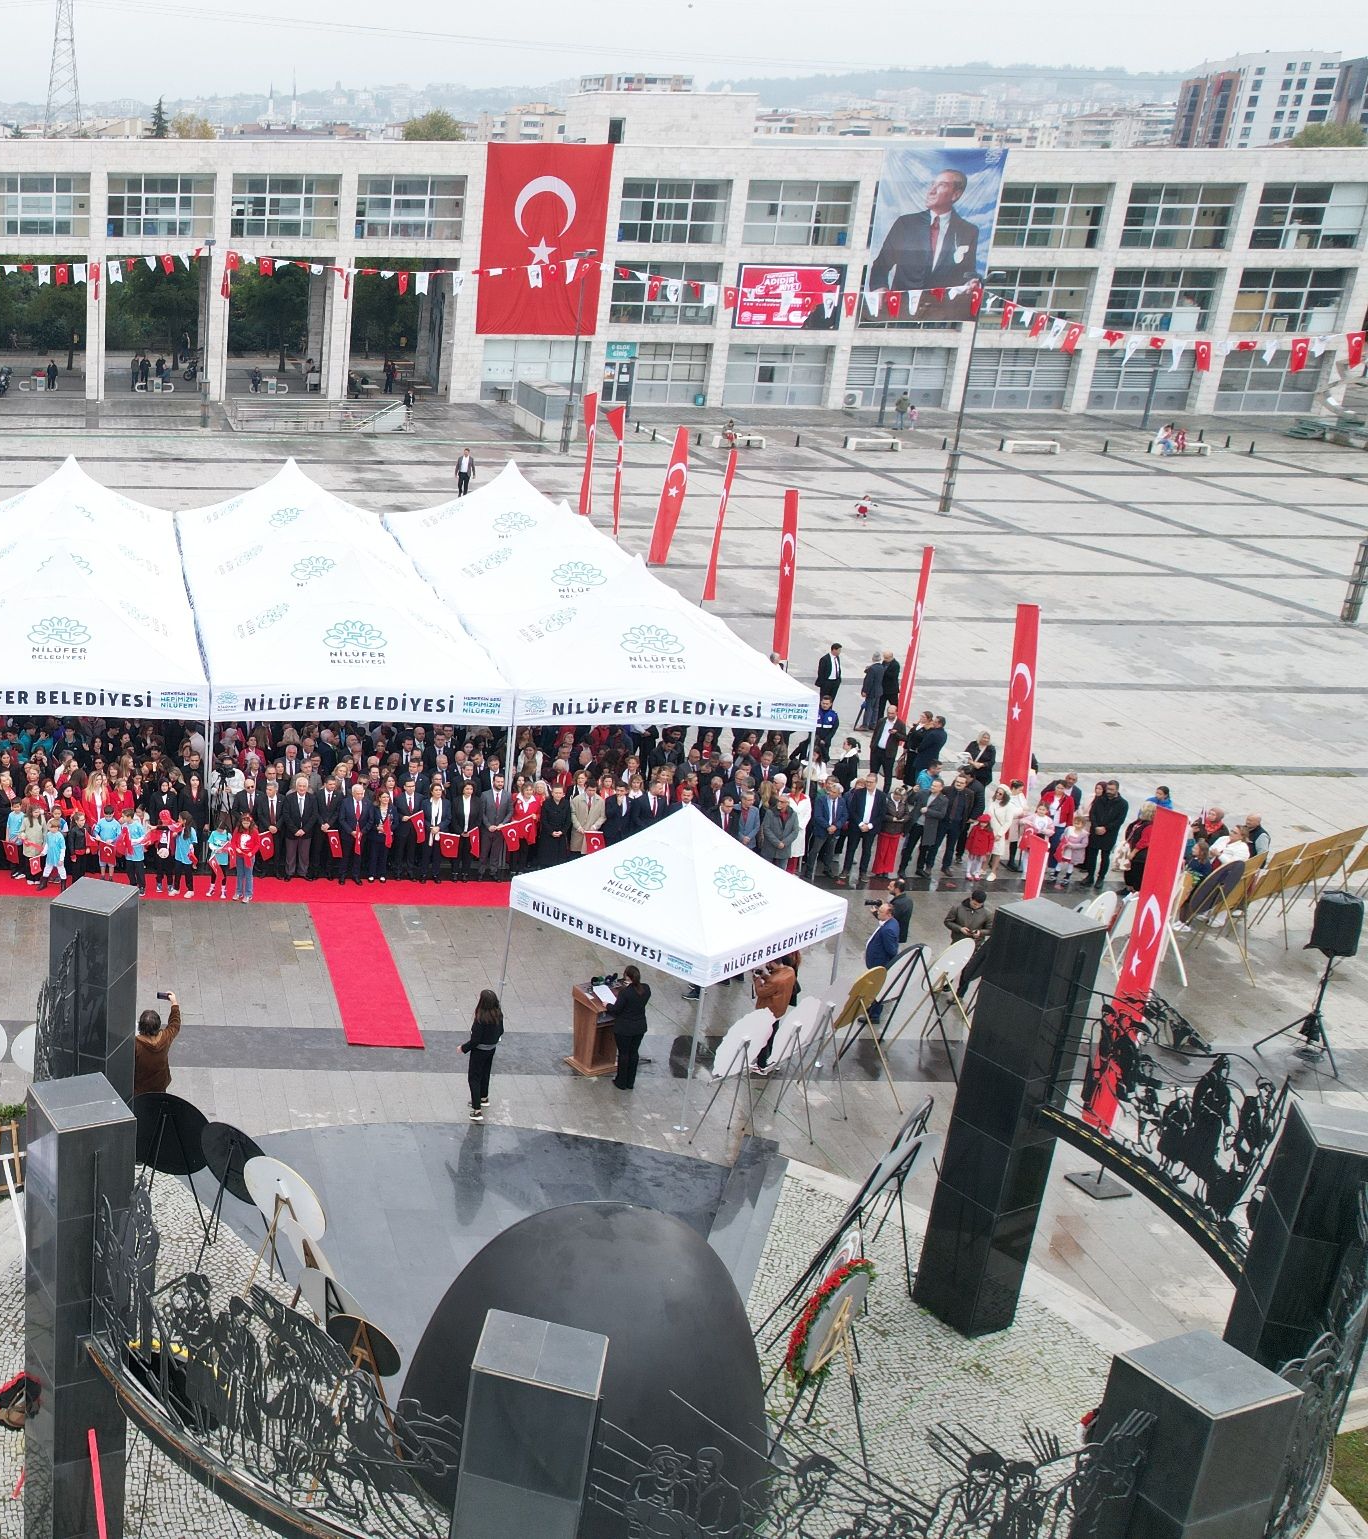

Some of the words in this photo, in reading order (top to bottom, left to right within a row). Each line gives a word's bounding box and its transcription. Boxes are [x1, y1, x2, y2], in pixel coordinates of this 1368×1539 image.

[36, 689, 152, 708] BELEDİYESİ
[244, 694, 330, 711] NİLÜFER
[336, 693, 455, 713] BELEDİYESİ
[552, 698, 638, 716] NİLÜFER
[644, 699, 762, 718] BELEDİYESİ
[607, 879, 651, 900] NİLÜFER
[731, 892, 764, 908] NİLÜFER
[532, 900, 583, 930] NİLÜFER
[587, 923, 662, 963] BELEDİYESİ
[723, 949, 763, 974] NİLÜFER
[766, 924, 818, 957] BELEDİYESİ
